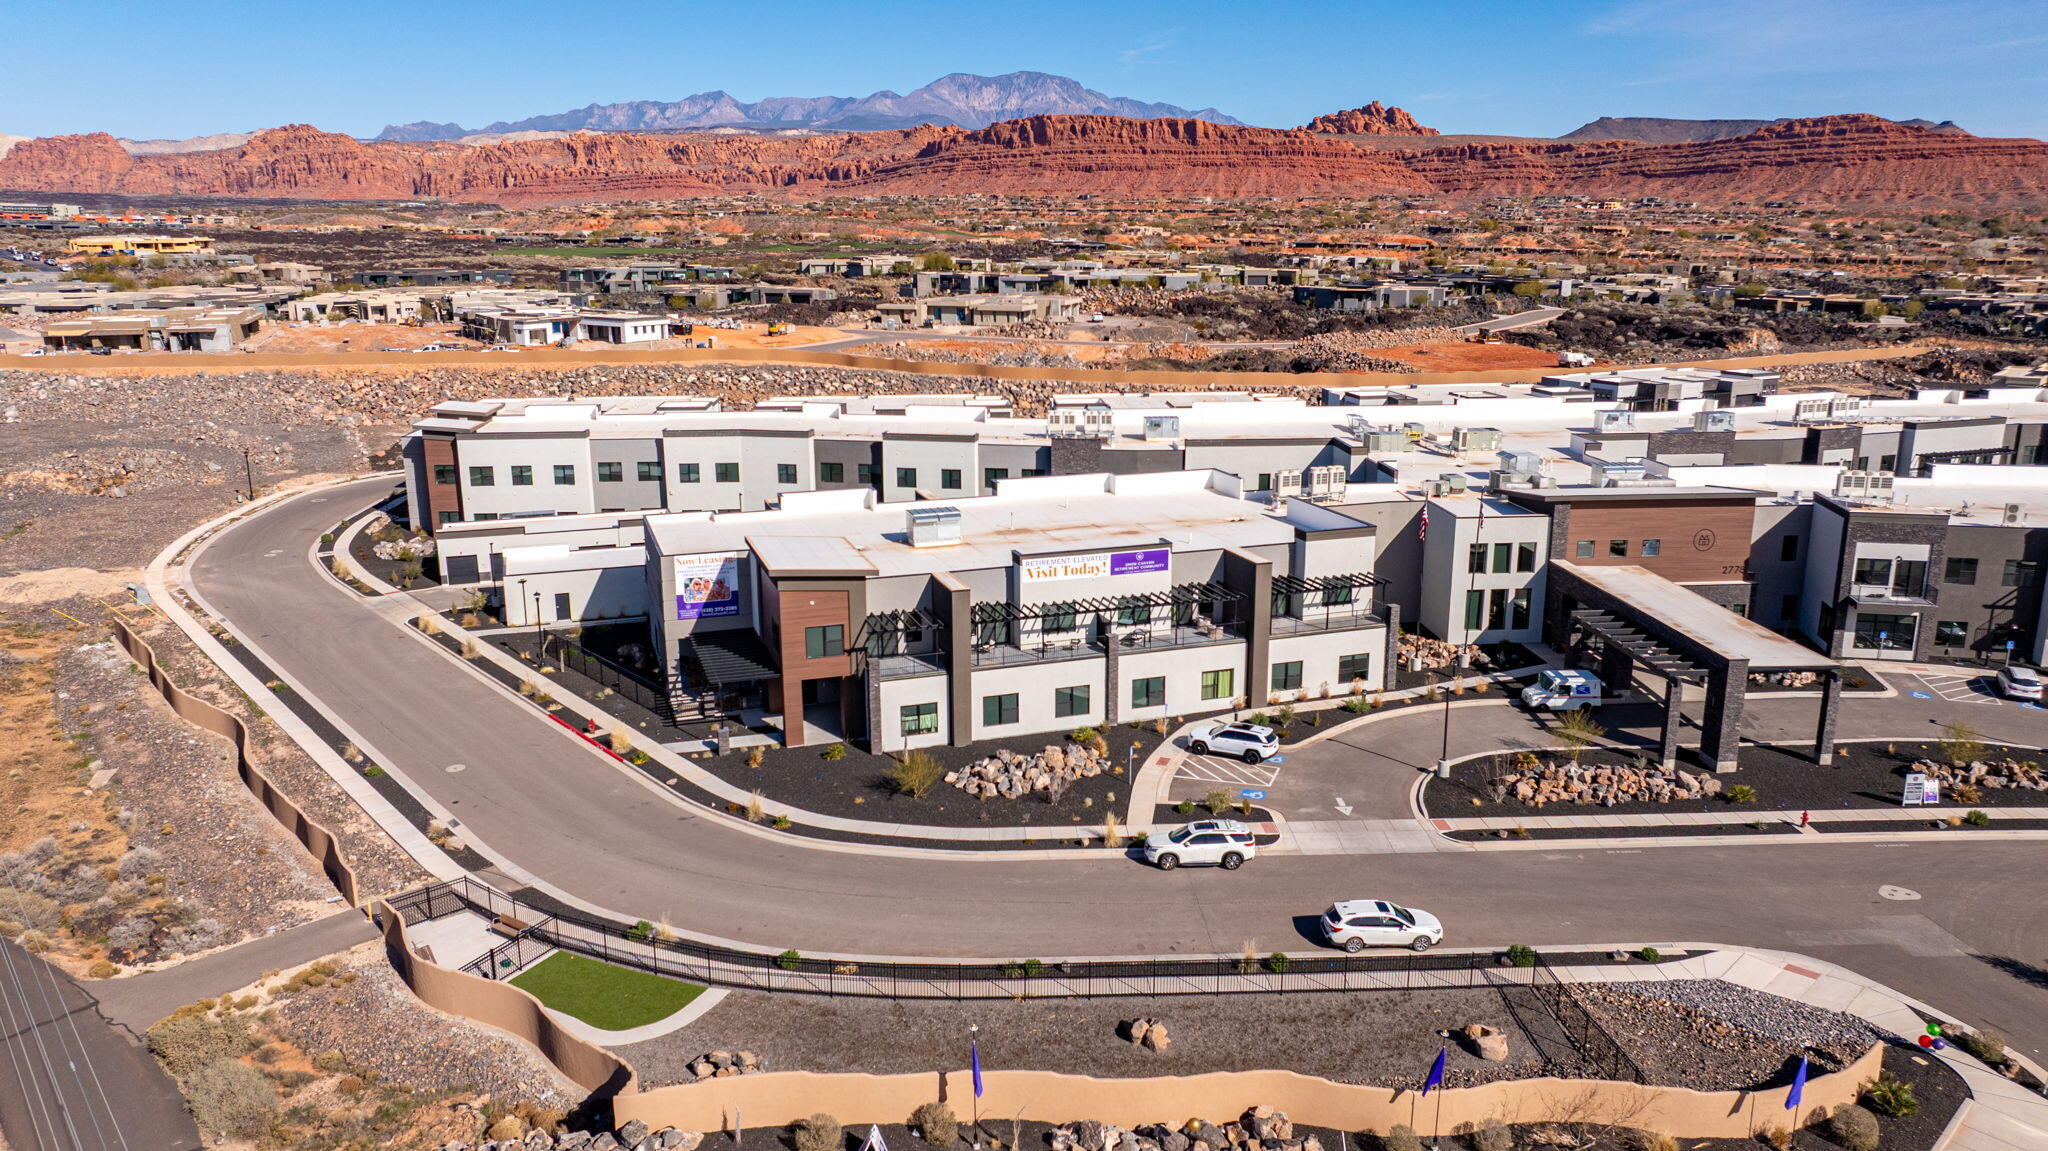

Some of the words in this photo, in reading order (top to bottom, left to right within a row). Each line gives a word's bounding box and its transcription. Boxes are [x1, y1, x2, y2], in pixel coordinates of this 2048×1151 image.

[675, 557, 695, 565] Now
[698, 555, 736, 565] Leasing!
[1025, 558, 1071, 567] RETIREMENT
[1073, 555, 1109, 564] ELEVATED
[1024, 566, 1057, 578] Visit
[1061, 561, 1107, 576] Today!
